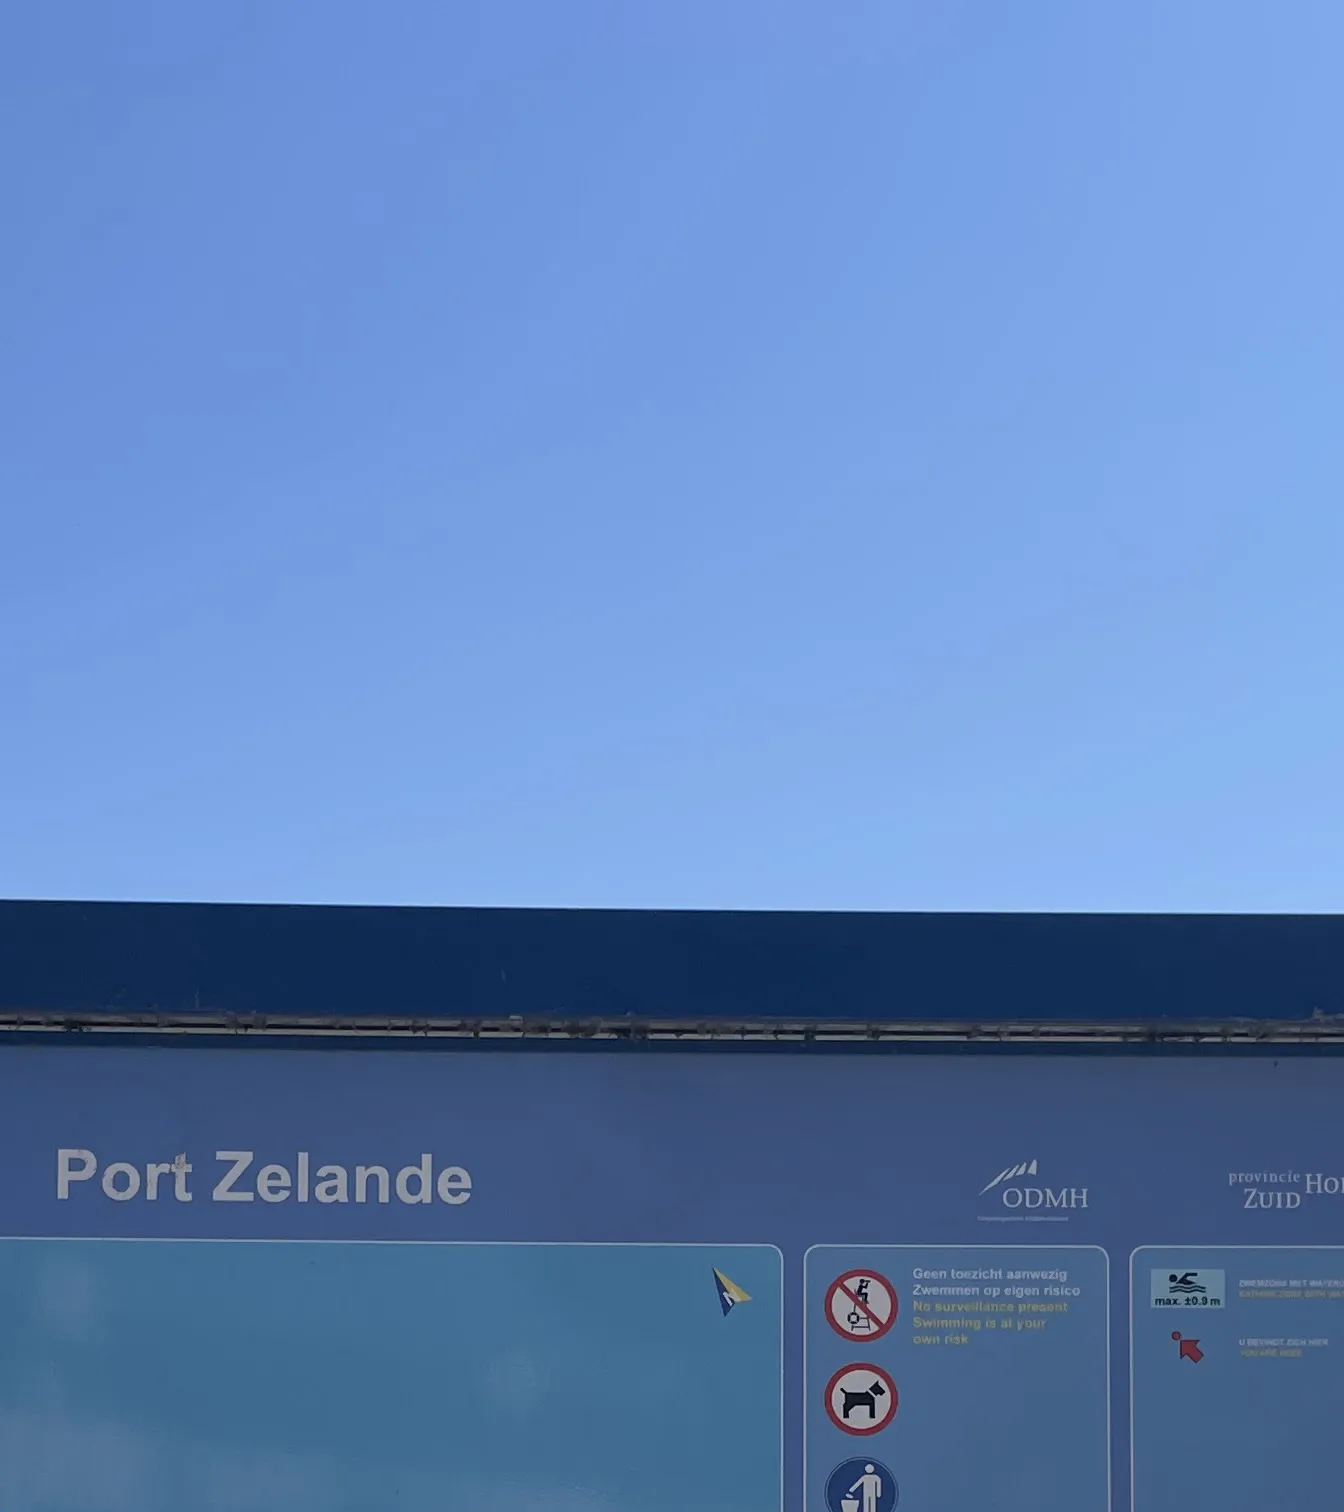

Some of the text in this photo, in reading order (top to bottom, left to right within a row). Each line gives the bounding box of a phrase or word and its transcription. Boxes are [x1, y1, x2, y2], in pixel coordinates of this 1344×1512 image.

[57, 1149, 473, 1204] Port Zelande
[1228, 1169, 1301, 1187] provincie
[1002, 1187, 1089, 1209] ODMH
